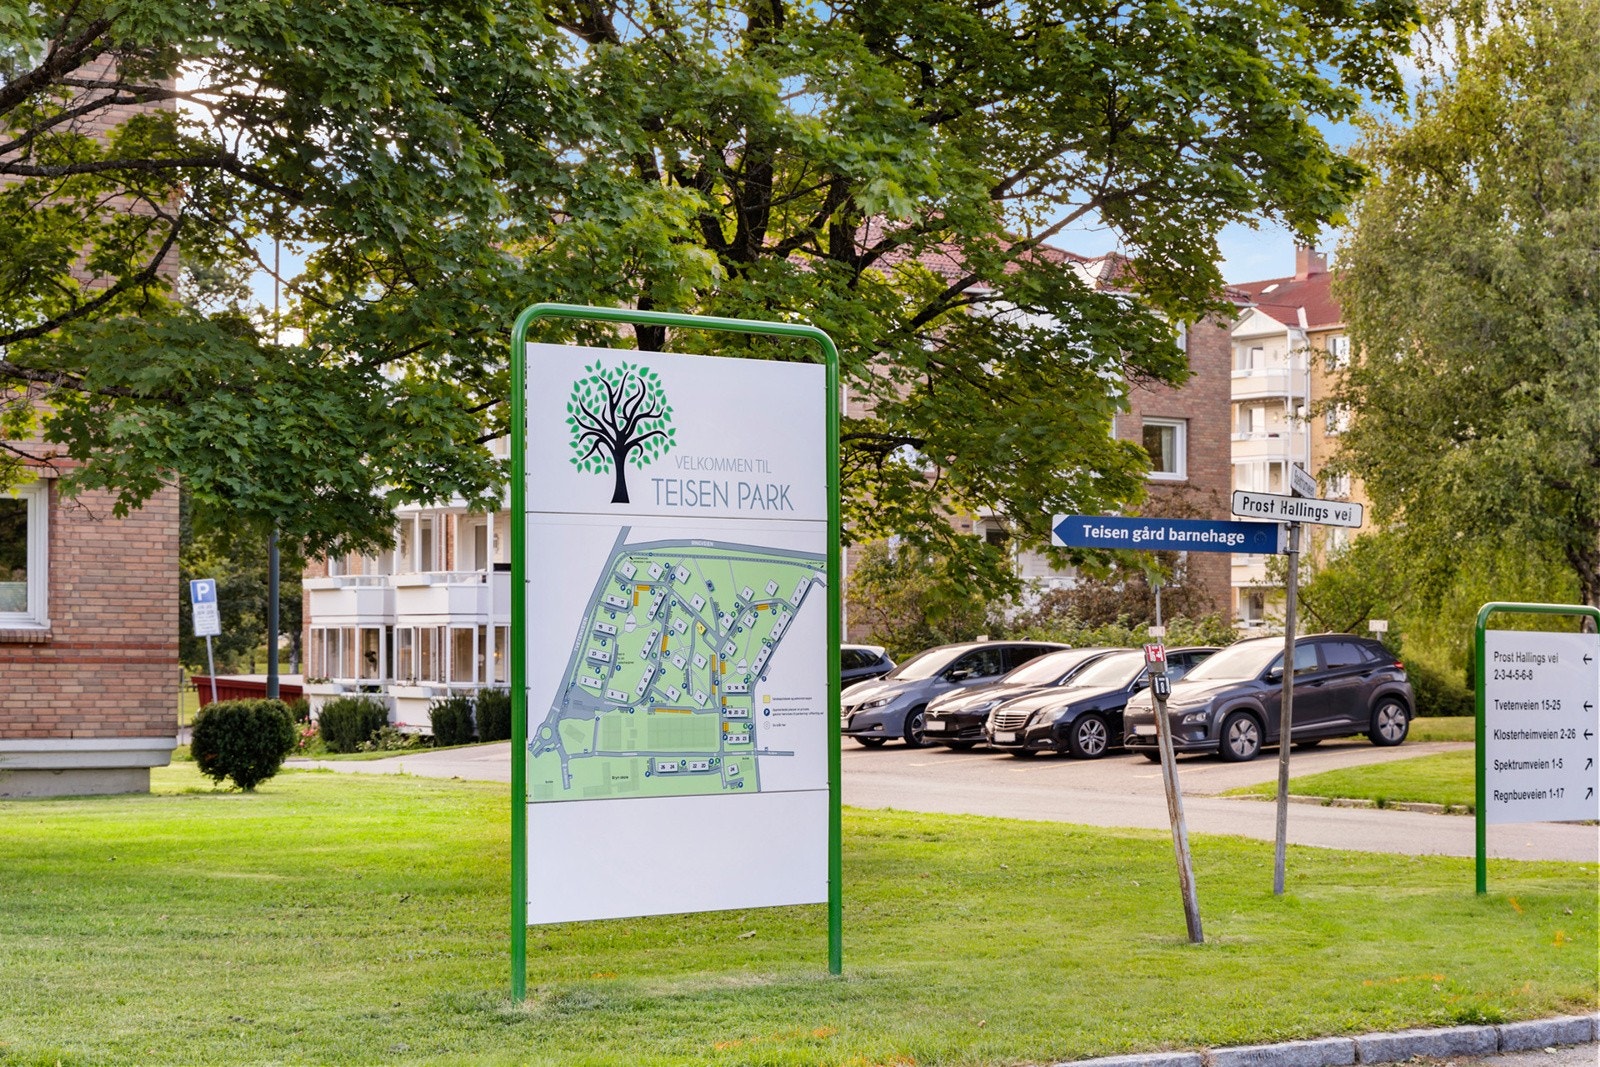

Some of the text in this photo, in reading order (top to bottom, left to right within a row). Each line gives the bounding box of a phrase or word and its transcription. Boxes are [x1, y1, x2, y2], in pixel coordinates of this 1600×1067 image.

[675, 455, 772, 474] VELKOMMEN TIL
[651, 478, 794, 511] TEISEN PARK
[1243, 496, 1352, 521] Prost Hallings vei
[1083, 525, 1245, 546] Teisen gård barnehage
[196, 582, 210, 601] P
[1493, 651, 1559, 666] Prost Hallings vei
[1493, 669, 1534, 681] 2-3-4-5-6-8
[1494, 699, 1561, 711] Tvetenveien 15-25
[1493, 728, 1577, 740] Klosterheimveien 2-26
[1493, 759, 1563, 772] Spektrumveien 1-5
[1493, 788, 1565, 803] Regnbueveien 1-17
